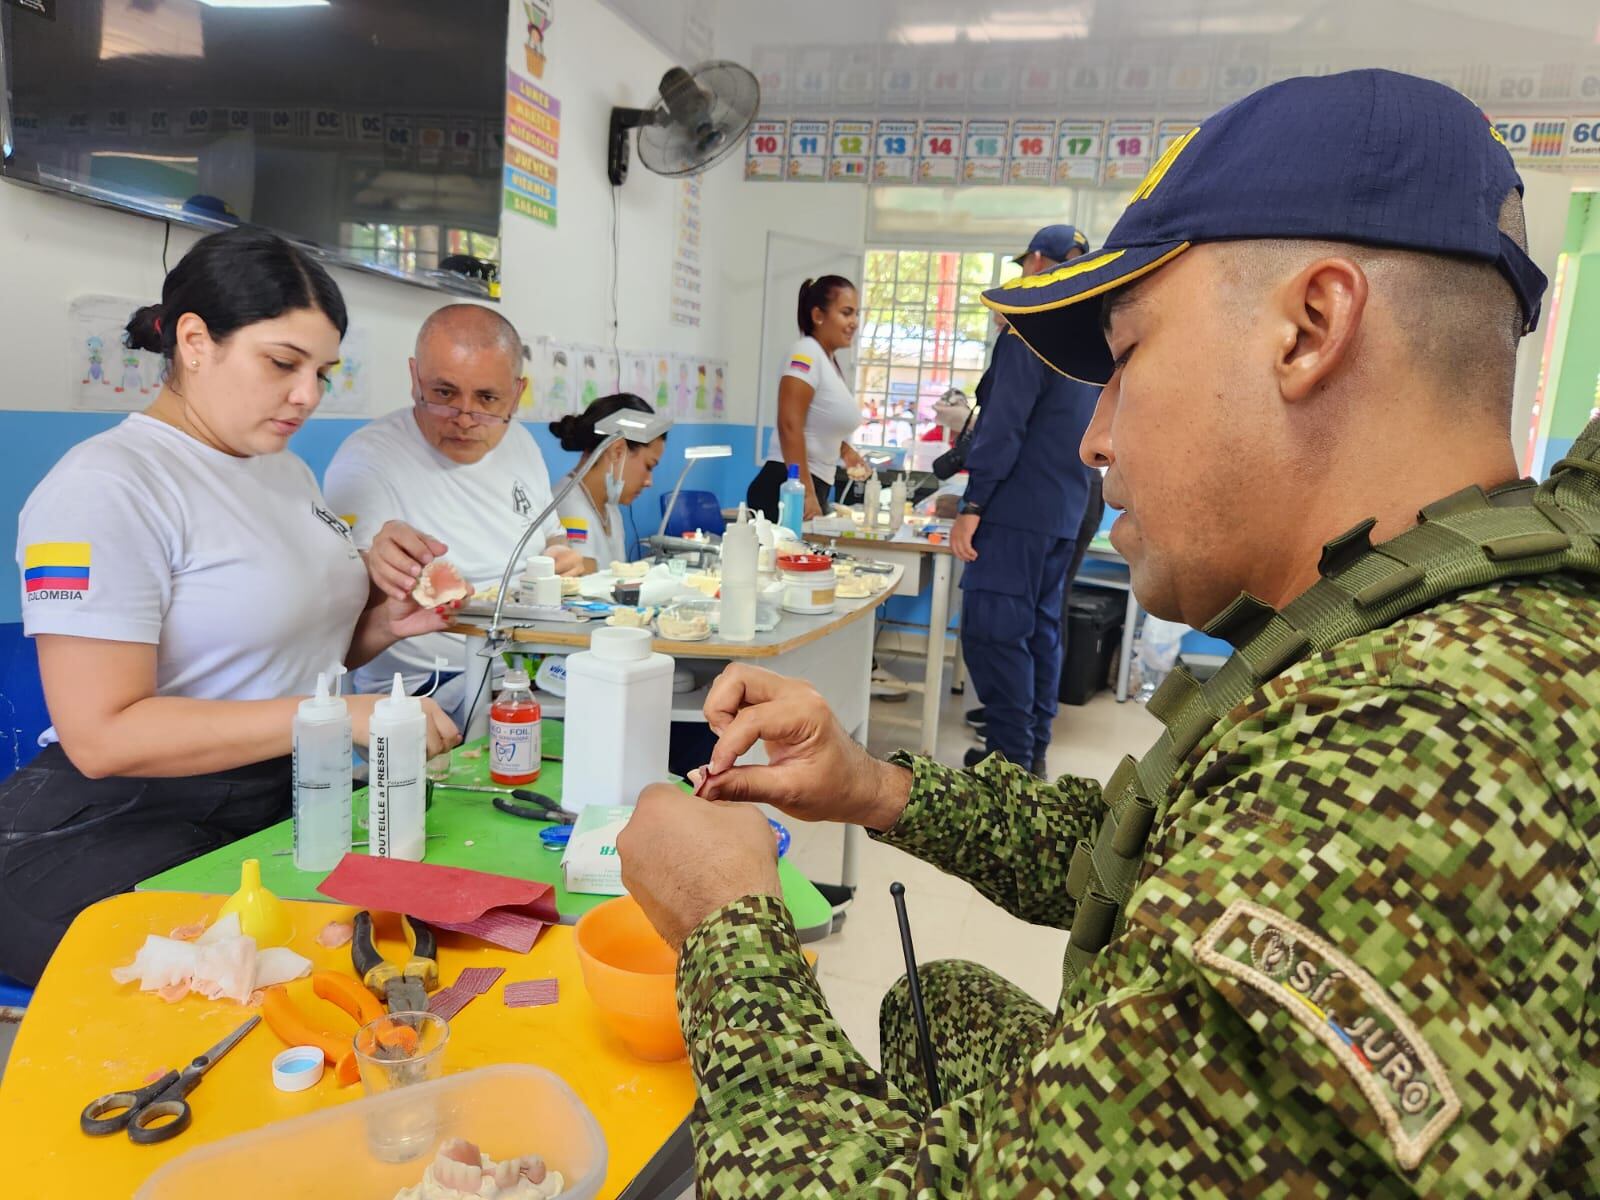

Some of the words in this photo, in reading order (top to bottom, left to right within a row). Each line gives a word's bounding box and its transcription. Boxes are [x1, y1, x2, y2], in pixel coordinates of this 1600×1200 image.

[755, 136, 777, 153] 10
[799, 137, 818, 154] 11
[839, 137, 863, 154] 12
[883, 137, 906, 154] 13
[929, 137, 953, 155] 14
[975, 138, 998, 155] 15
[1019, 137, 1043, 155] 16
[1067, 138, 1092, 155] 17
[1117, 138, 1142, 156] 18
[377, 736, 385, 788] PRESSER
[1343, 1018, 1431, 1115] JURO
